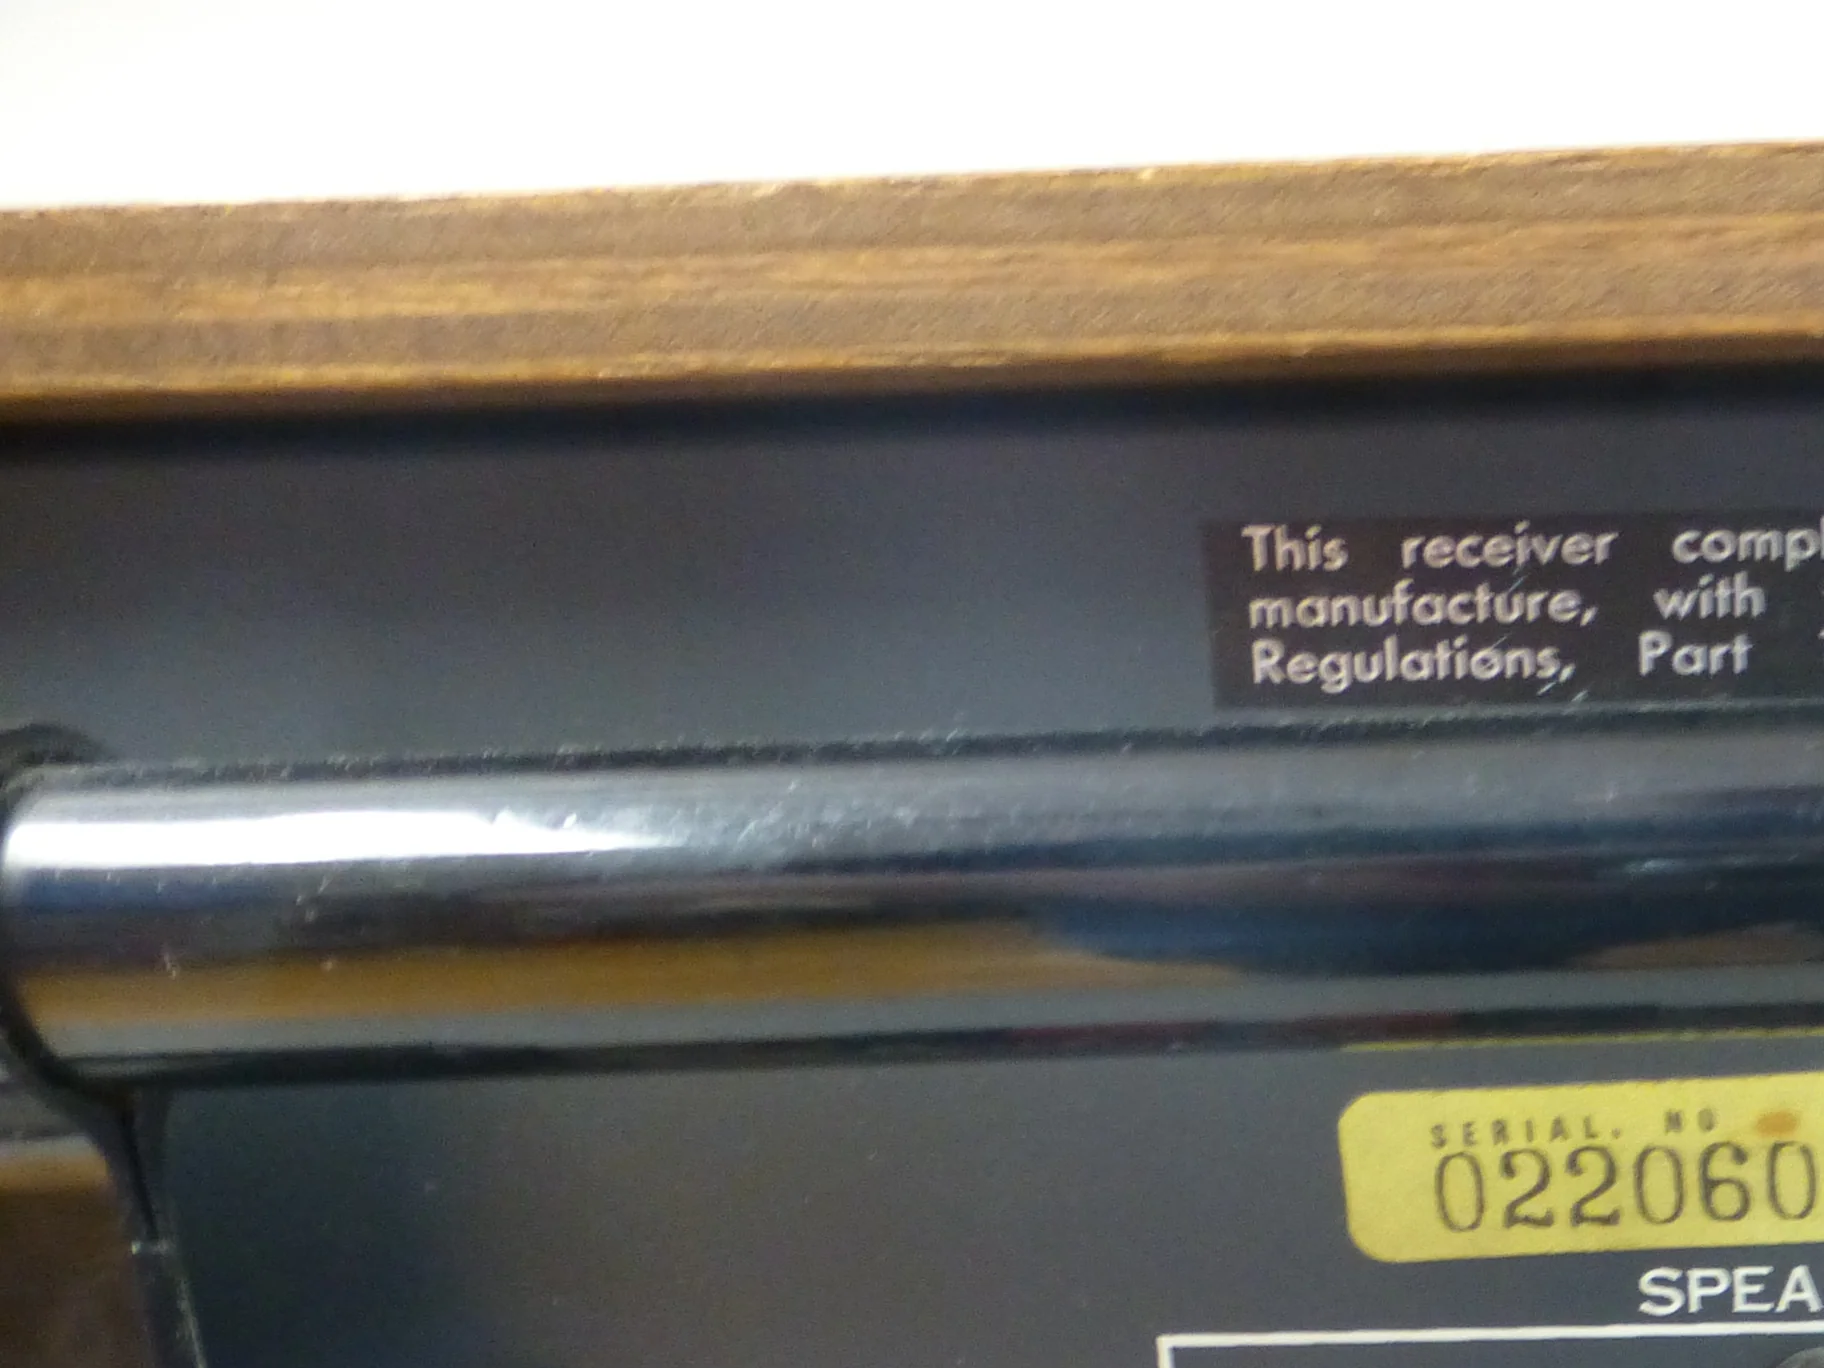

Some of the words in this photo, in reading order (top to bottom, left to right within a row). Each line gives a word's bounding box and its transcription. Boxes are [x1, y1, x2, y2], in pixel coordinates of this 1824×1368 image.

[1241, 523, 1349, 572] This
[1400, 520, 1620, 569] receiver
[1248, 579, 1600, 629] manufacture,
[1653, 572, 1767, 622] with
[1250, 636, 1577, 695] Regulations,
[1637, 630, 1755, 677] Part
